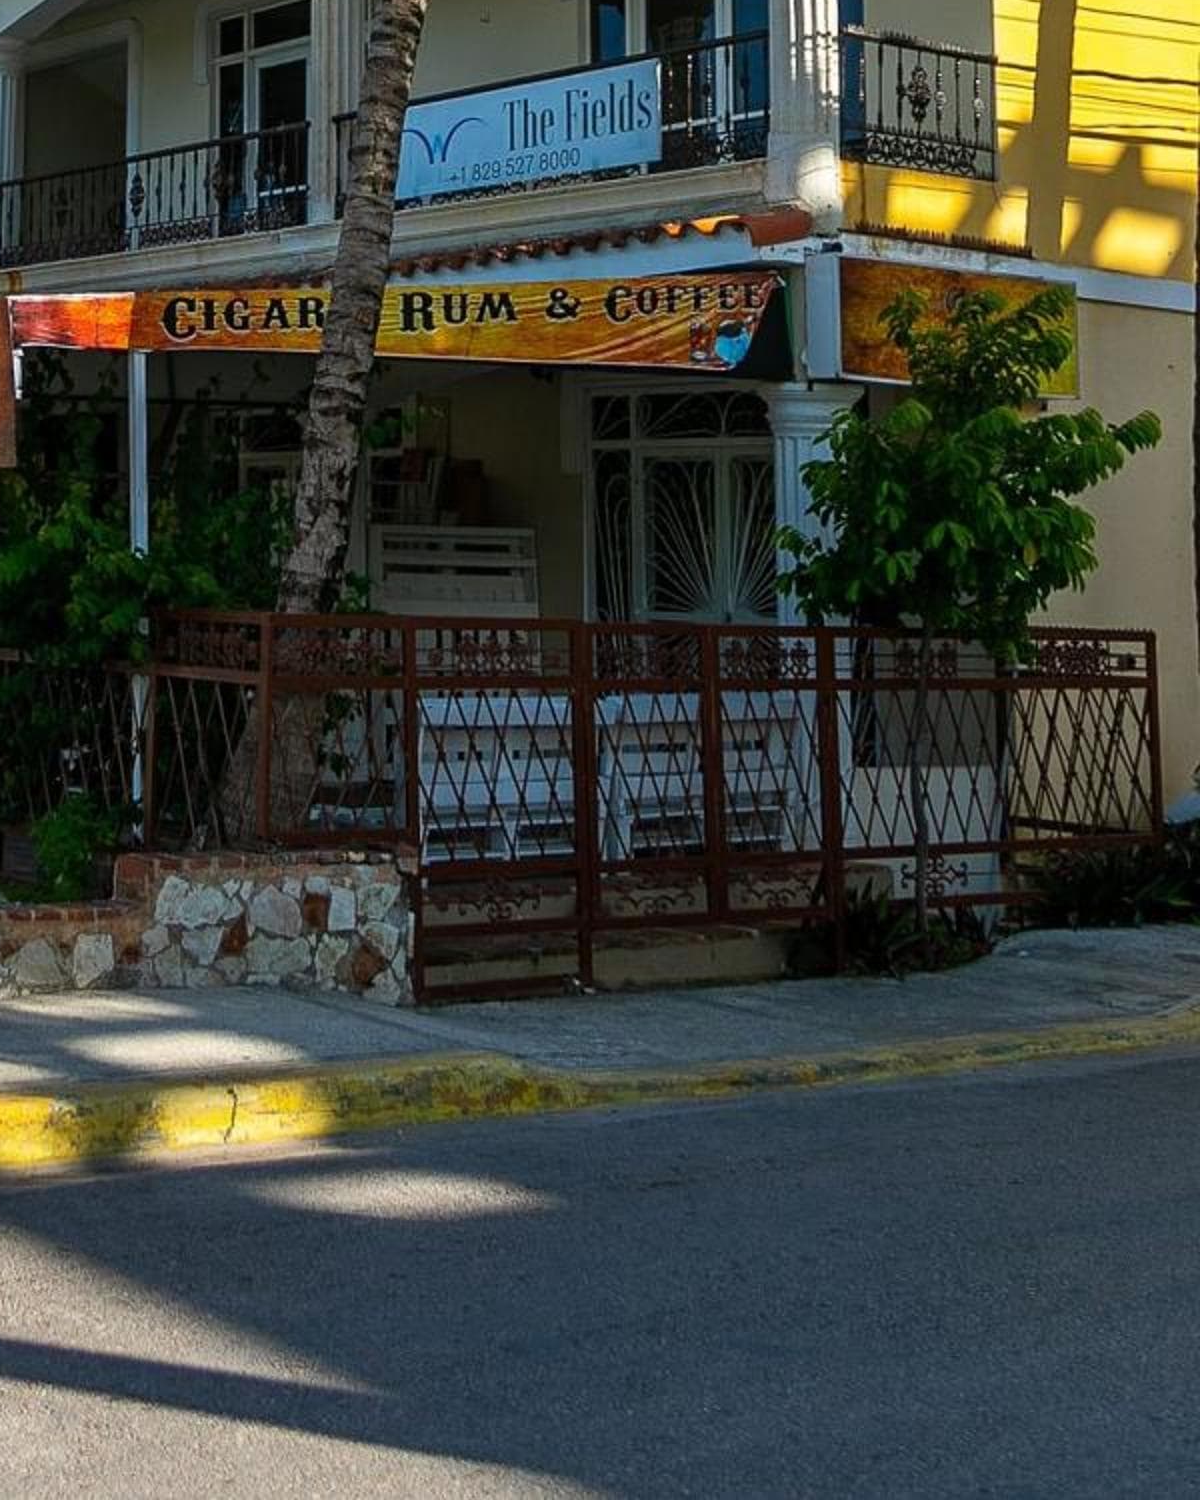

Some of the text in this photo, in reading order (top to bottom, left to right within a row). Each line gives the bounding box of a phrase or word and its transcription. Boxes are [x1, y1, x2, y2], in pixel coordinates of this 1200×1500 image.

[503, 79, 653, 152] The Fields
[471, 161, 501, 181] 829
[505, 155, 534, 177] 527
[539, 147, 581, 171] 8000
[161, 284, 763, 340] CIGAR RUM & COFFEE
